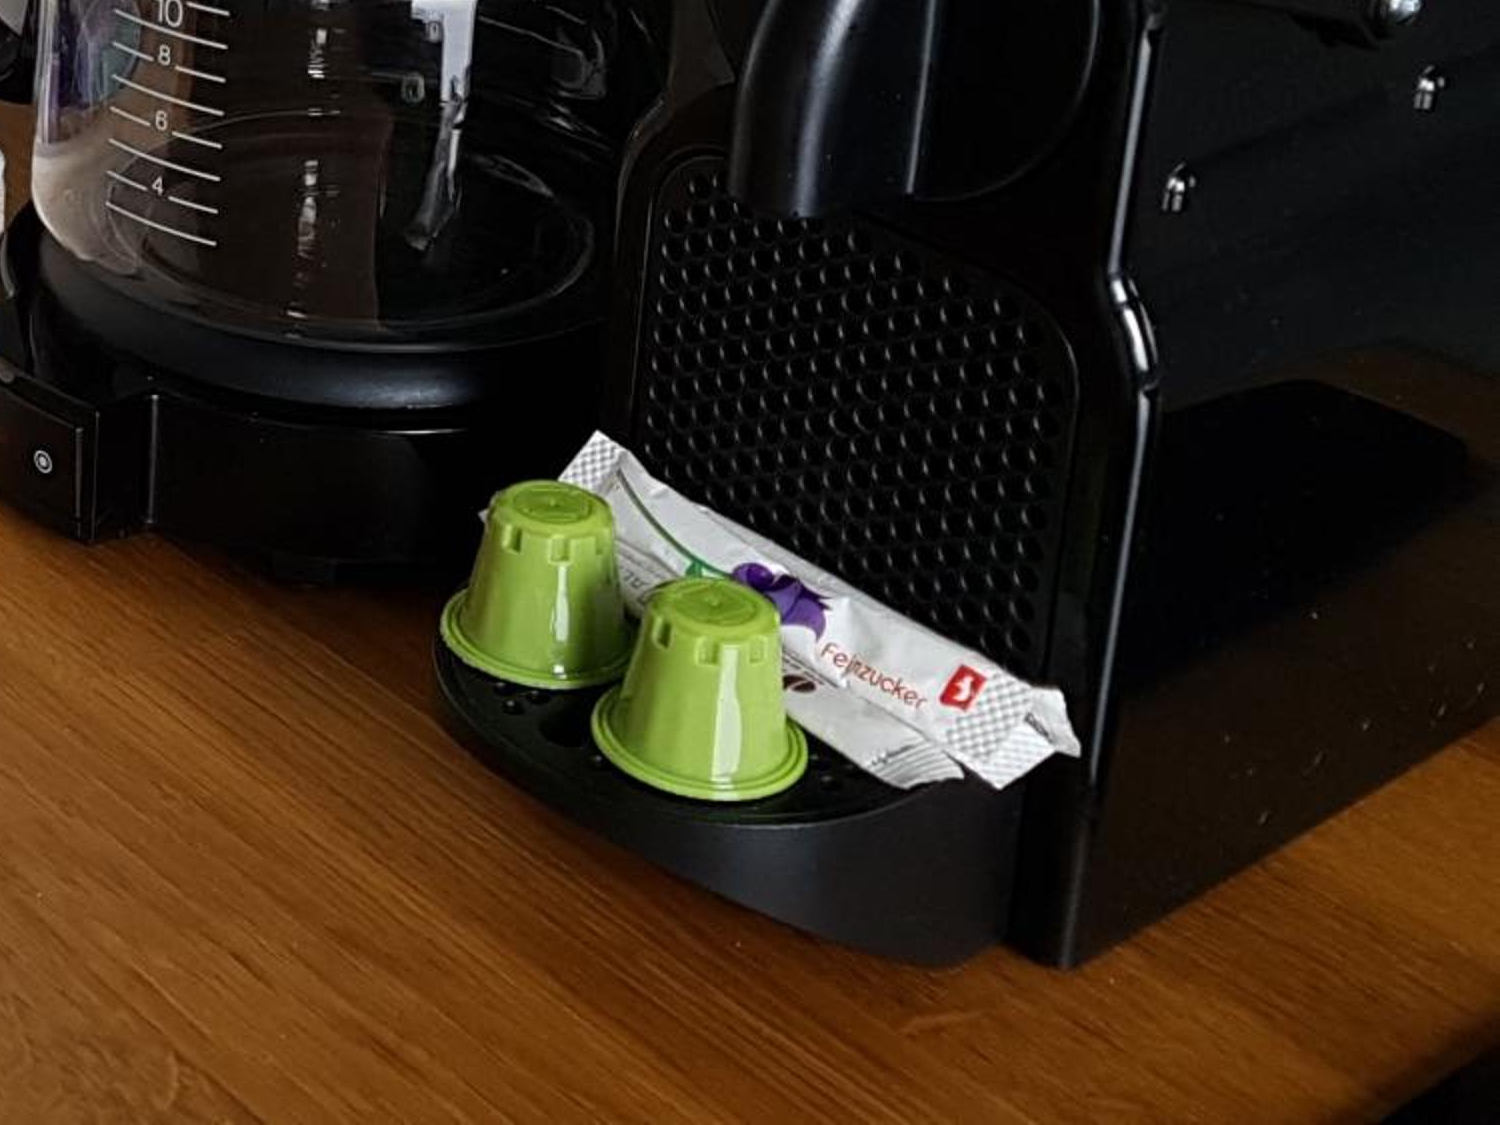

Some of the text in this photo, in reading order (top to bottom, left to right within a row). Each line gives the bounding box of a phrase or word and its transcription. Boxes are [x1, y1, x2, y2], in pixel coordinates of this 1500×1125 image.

[157, 43, 171, 66] 8
[155, 109, 168, 131] 6
[151, 176, 164, 197] 4
